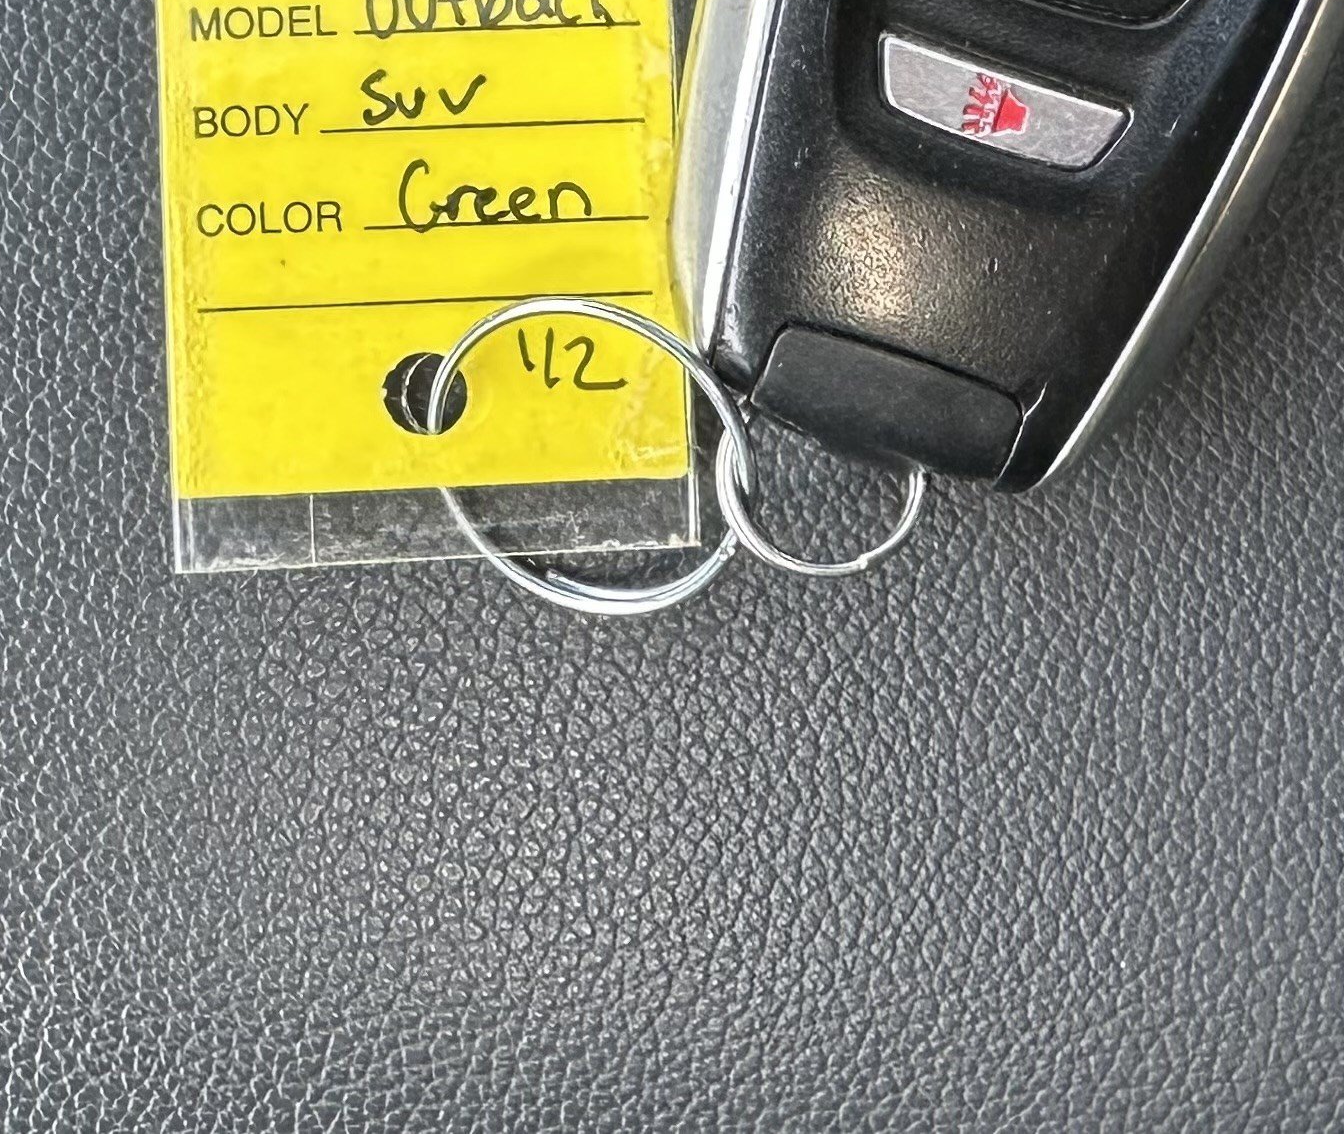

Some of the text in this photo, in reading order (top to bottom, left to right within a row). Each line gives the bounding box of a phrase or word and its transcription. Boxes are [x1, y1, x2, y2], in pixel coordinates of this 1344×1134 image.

[190, 5, 337, 42] MODEL
[193, 103, 310, 139] BODY
[398, 158, 592, 234] Green
[197, 200, 343, 238] COLOR
